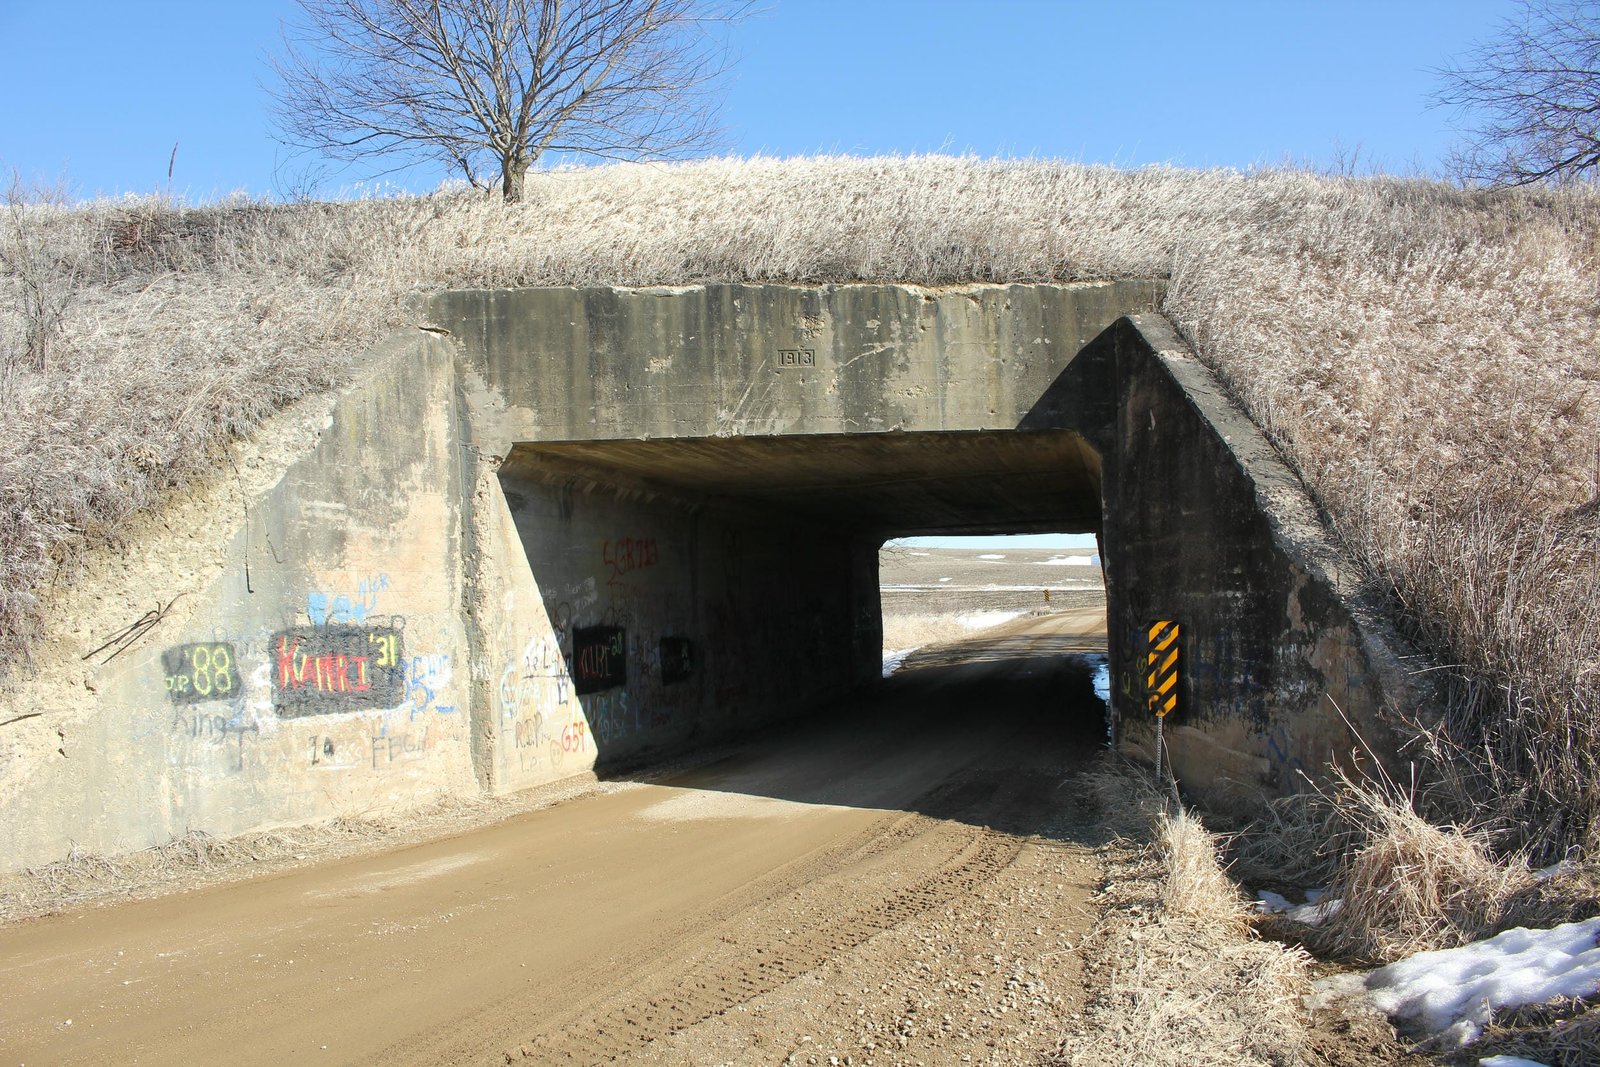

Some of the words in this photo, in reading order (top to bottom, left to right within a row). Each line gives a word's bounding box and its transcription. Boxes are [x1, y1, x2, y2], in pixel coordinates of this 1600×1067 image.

[780, 352, 812, 365] 1913
[277, 635, 373, 693] KAMRI
[369, 633, 397, 667] '31
[561, 721, 585, 753] G59
